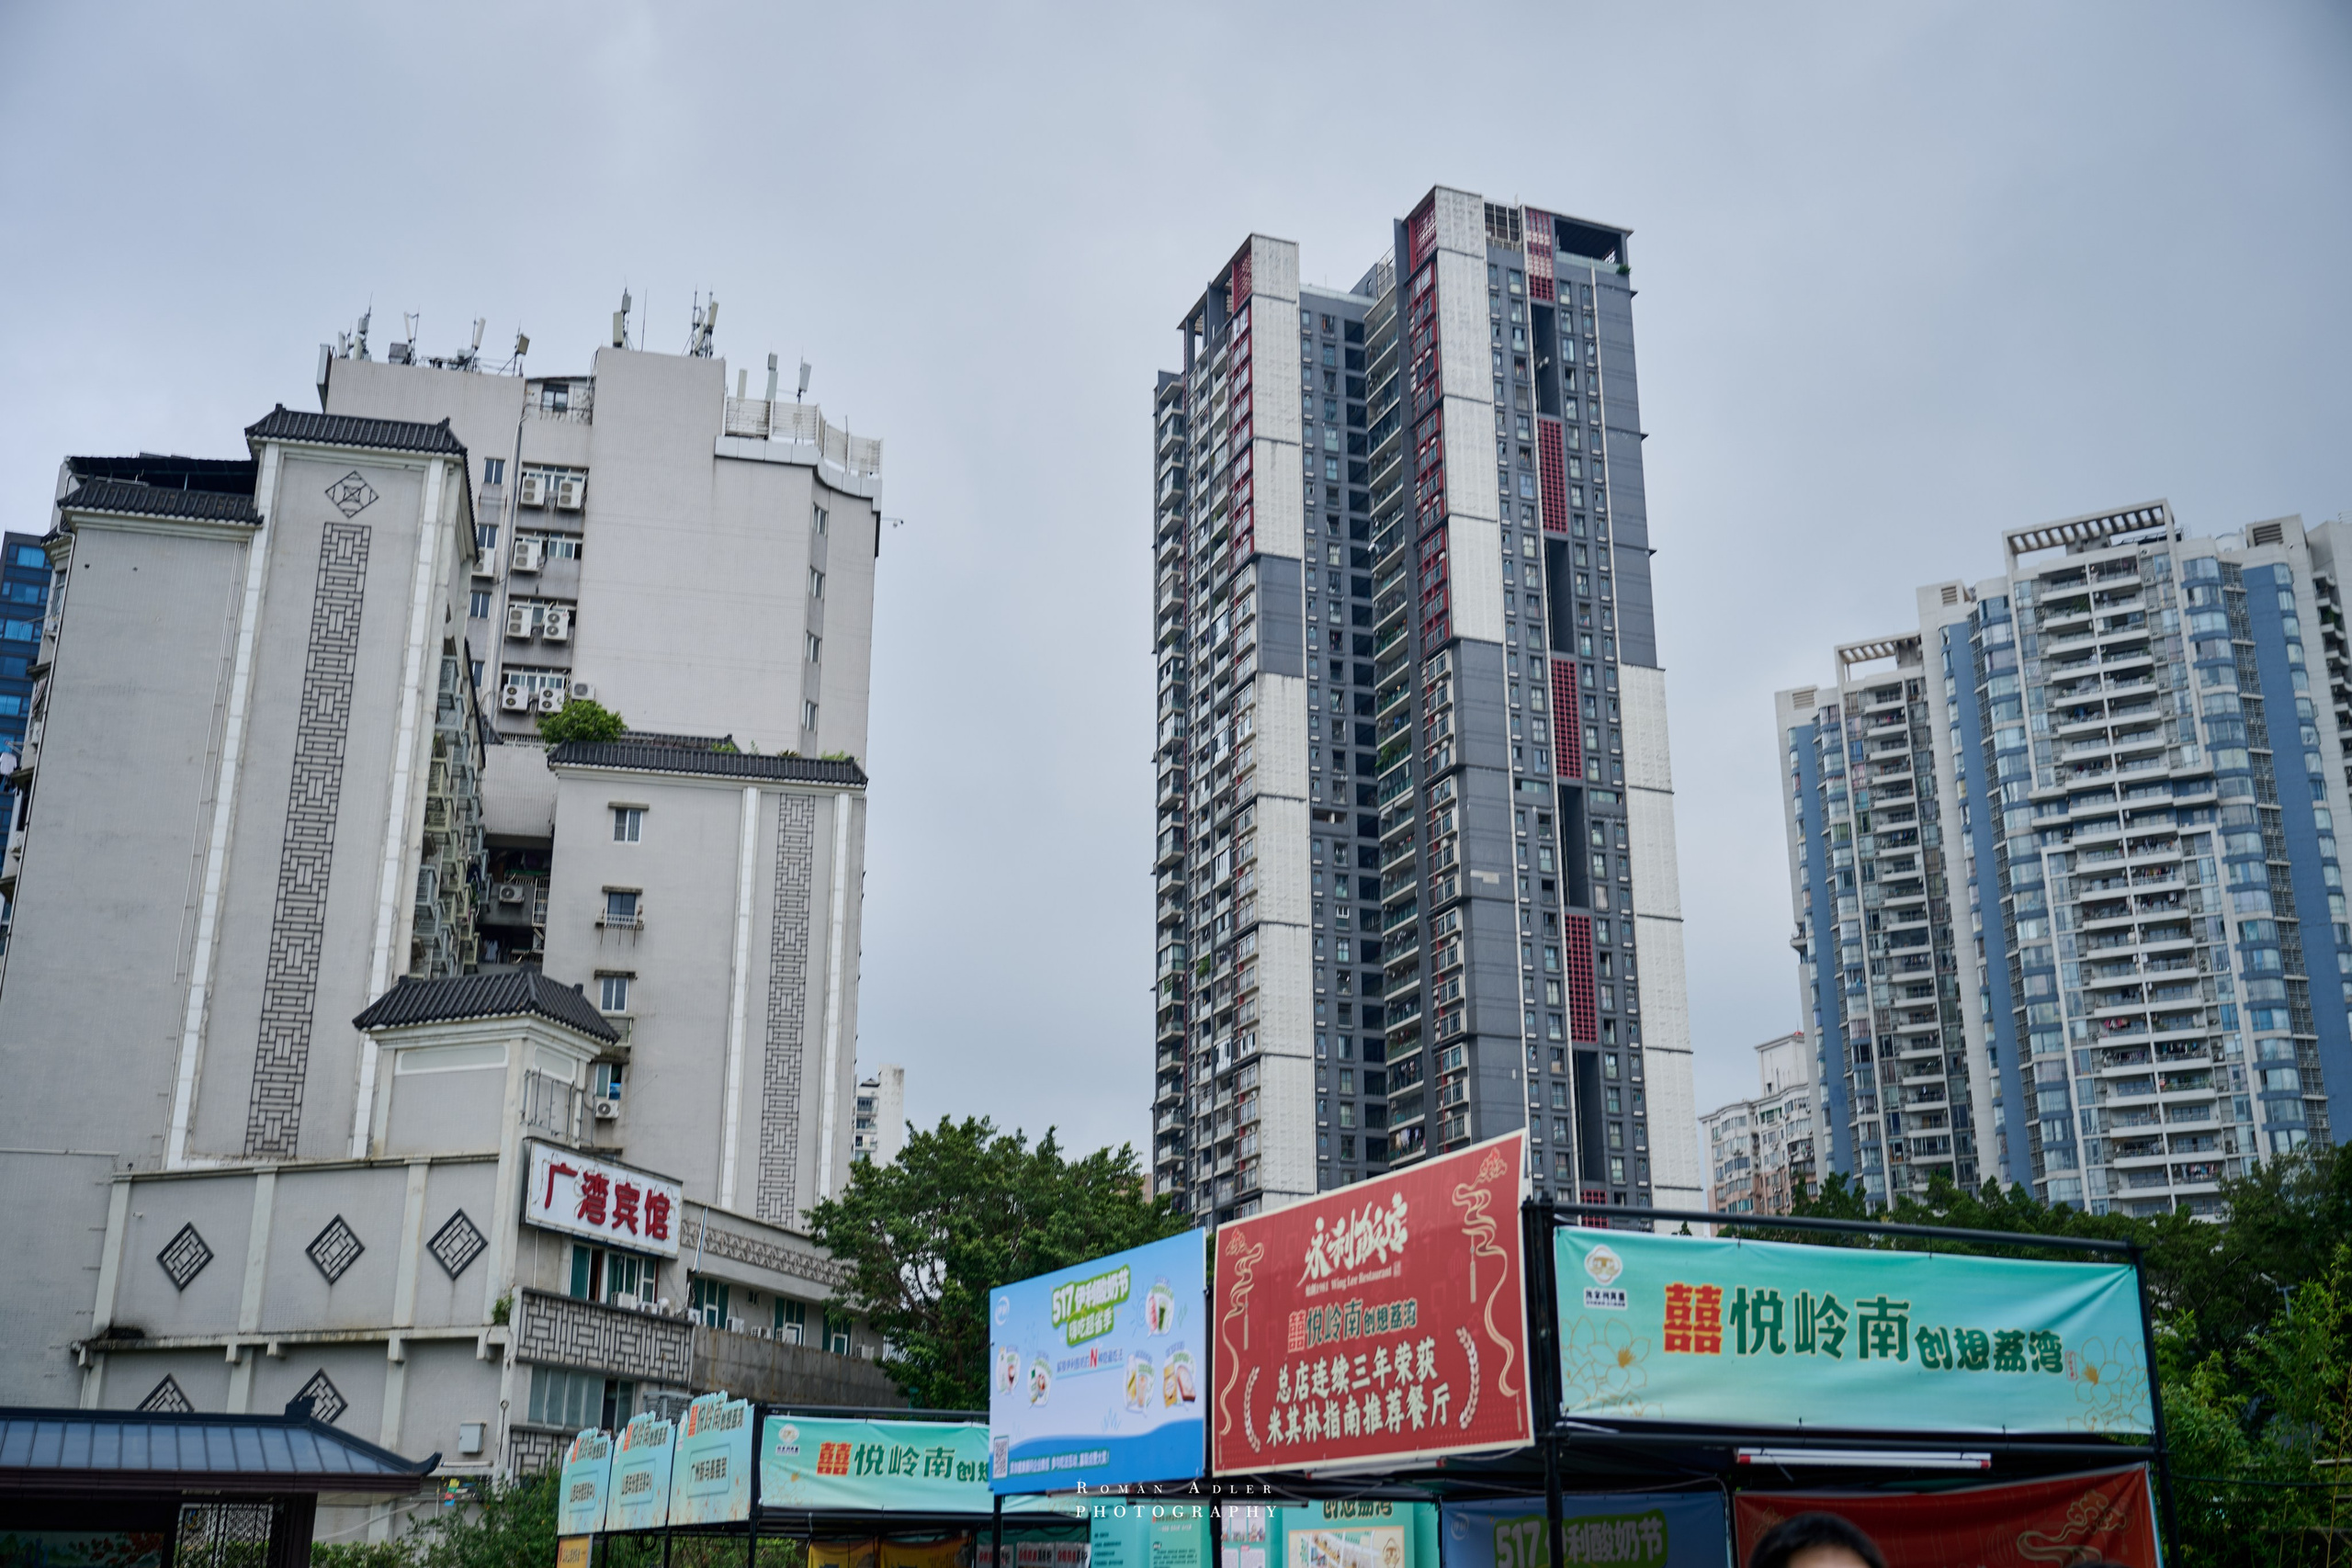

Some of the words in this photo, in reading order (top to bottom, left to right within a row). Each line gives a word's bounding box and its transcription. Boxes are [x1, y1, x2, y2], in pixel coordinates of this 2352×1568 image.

[544, 1162, 671, 1240] 广湾宾馆
[1276, 1335, 1438, 1404] 总店连续三年荣获
[1266, 1382, 1451, 1449] 米其林指南推荐餐厅
[1496, 1517, 1663, 1568] 517利酸奶节
